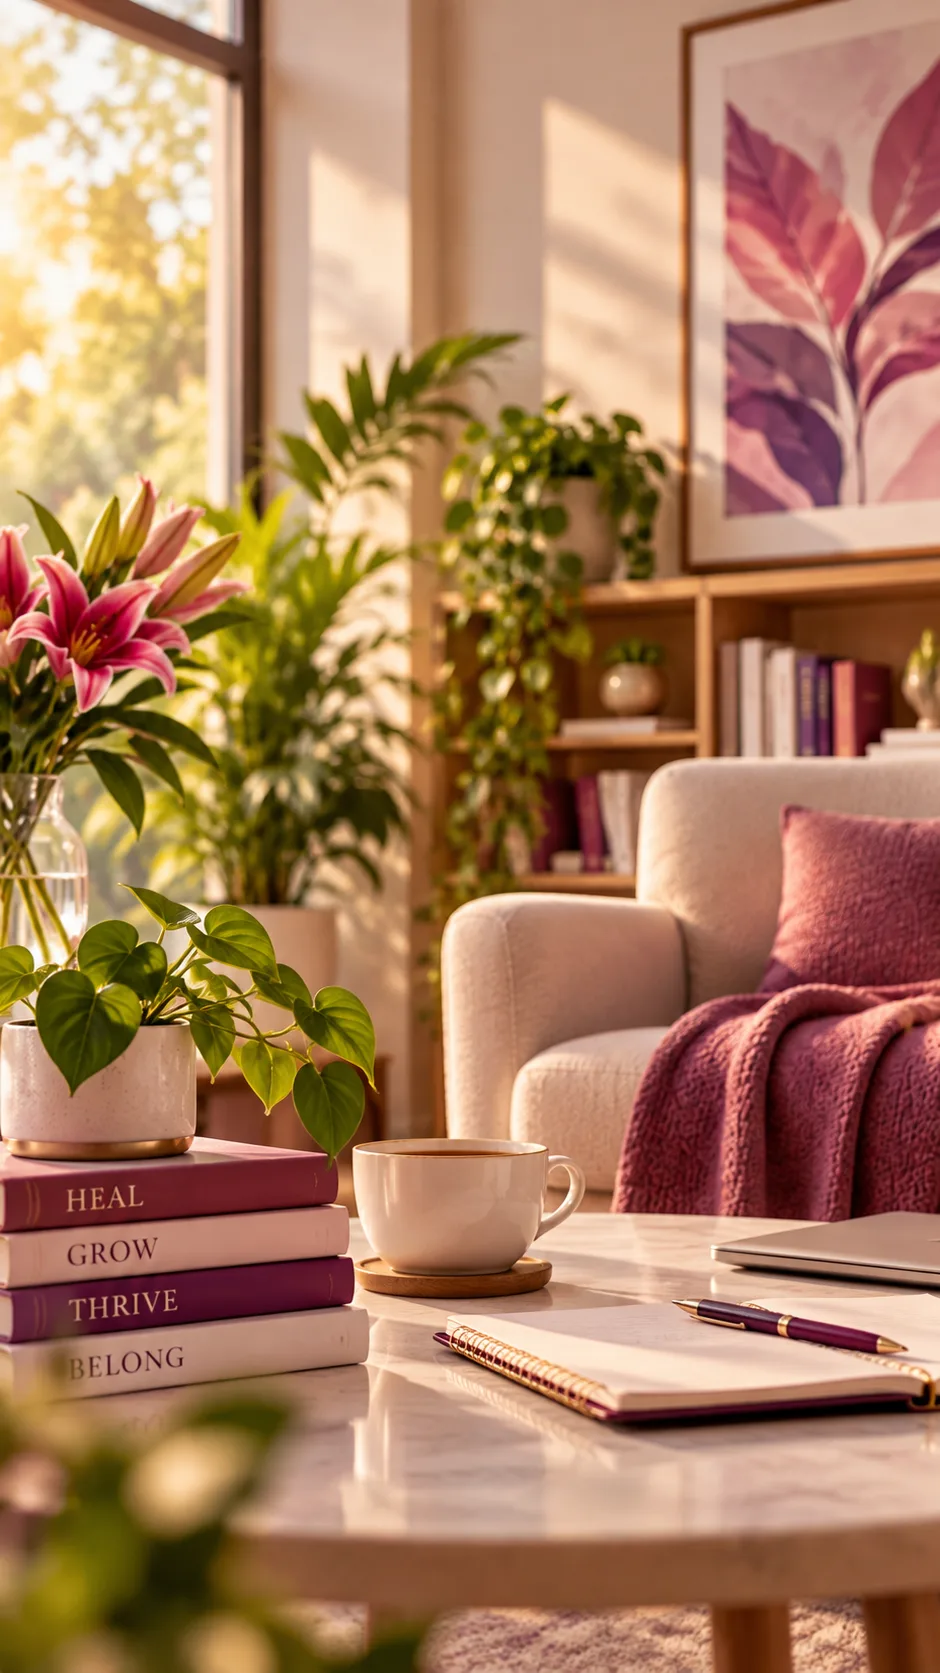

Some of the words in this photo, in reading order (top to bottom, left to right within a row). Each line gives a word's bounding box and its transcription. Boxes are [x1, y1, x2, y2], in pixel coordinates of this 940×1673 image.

[66, 1185, 144, 1212] HEAL
[67, 1237, 158, 1266] GROW
[68, 1289, 178, 1322] THRIVE
[69, 1346, 184, 1380] BELONG
